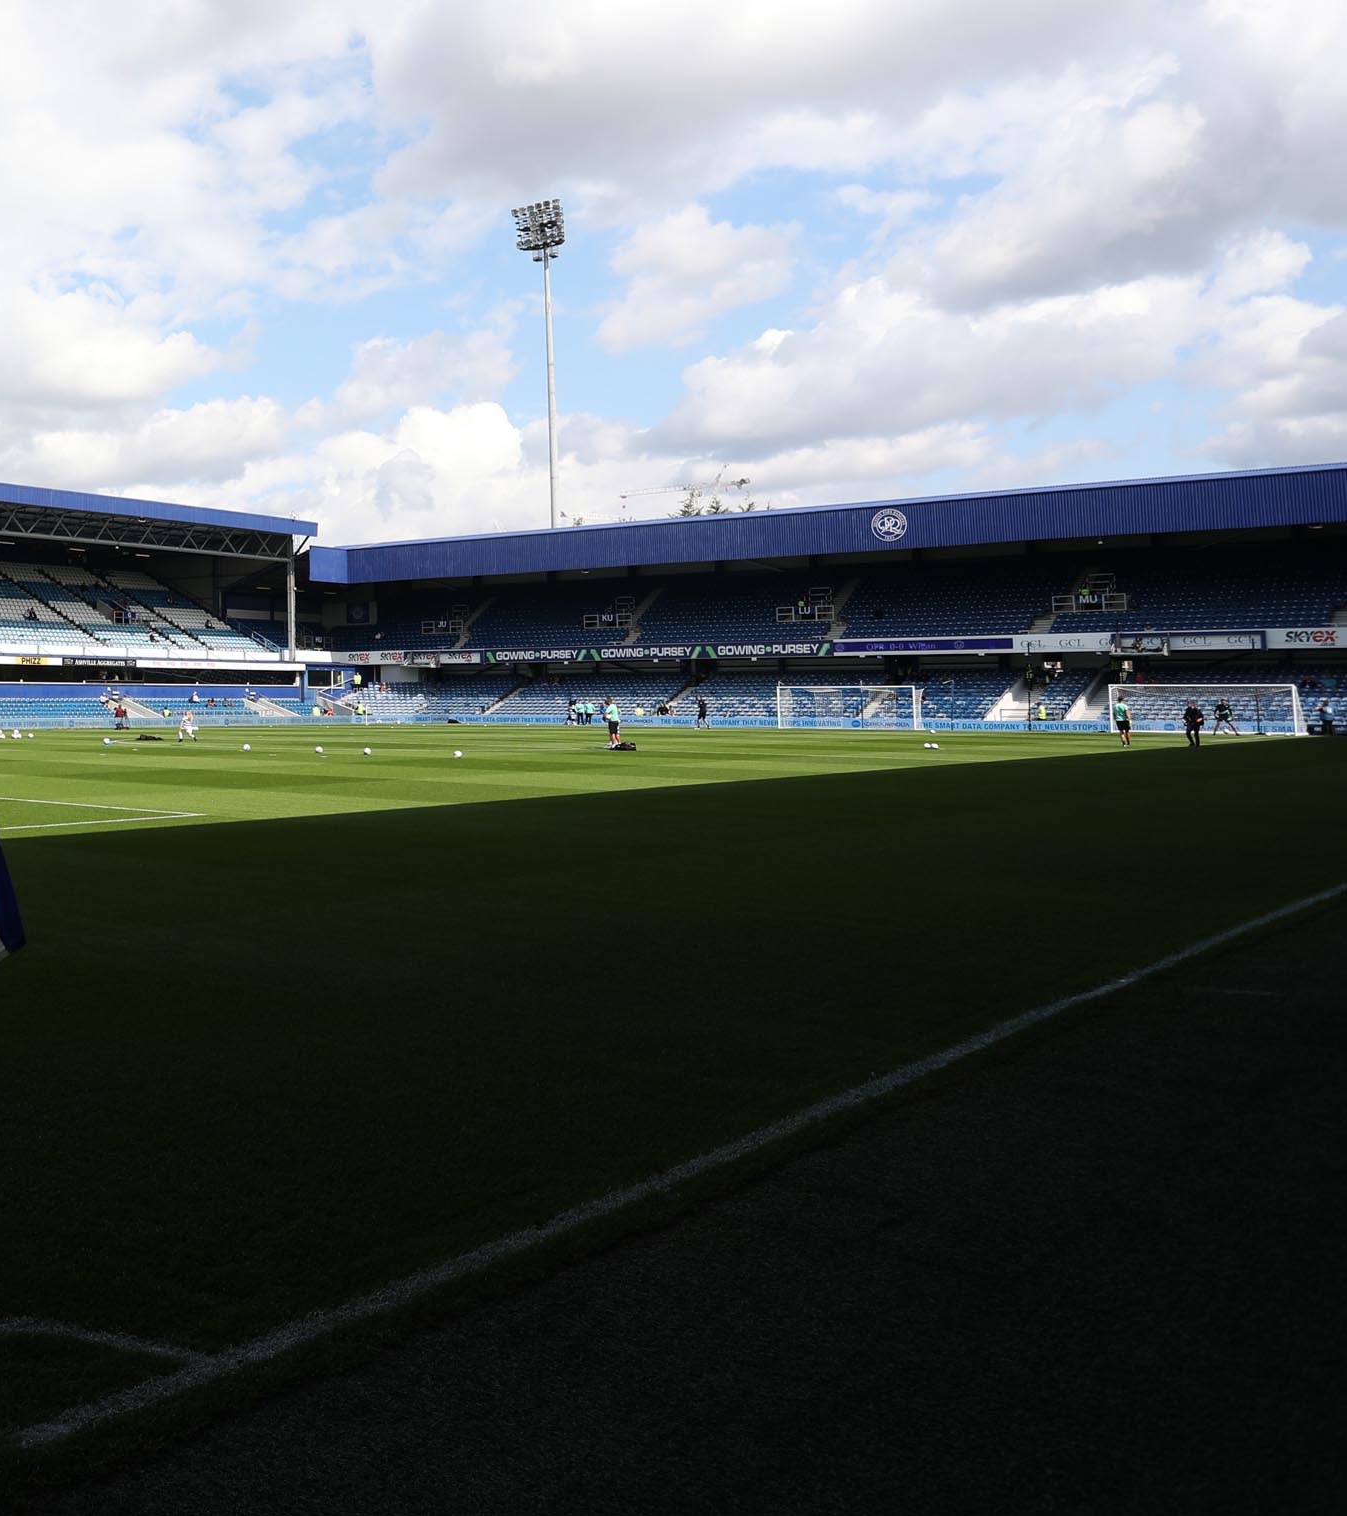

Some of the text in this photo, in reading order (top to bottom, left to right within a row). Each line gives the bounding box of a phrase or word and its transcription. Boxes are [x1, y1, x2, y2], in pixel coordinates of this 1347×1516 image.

[1079, 594, 1098, 604] MU
[602, 614, 613, 622] KU
[1058, 638, 1085, 648] GCL
[1183, 635, 1211, 645] GCL
[496, 649, 578, 661] GOWING PURSEY
[601, 646, 692, 658] GOWING PURSEY
[717, 643, 820, 656] GOWING PURSEY
[21, 657, 41, 665] PHIZZ
[984, 722, 1020, 730] COMPANY
[1044, 723, 1070, 731] NEVER
[1072, 723, 1098, 731] STOPS
